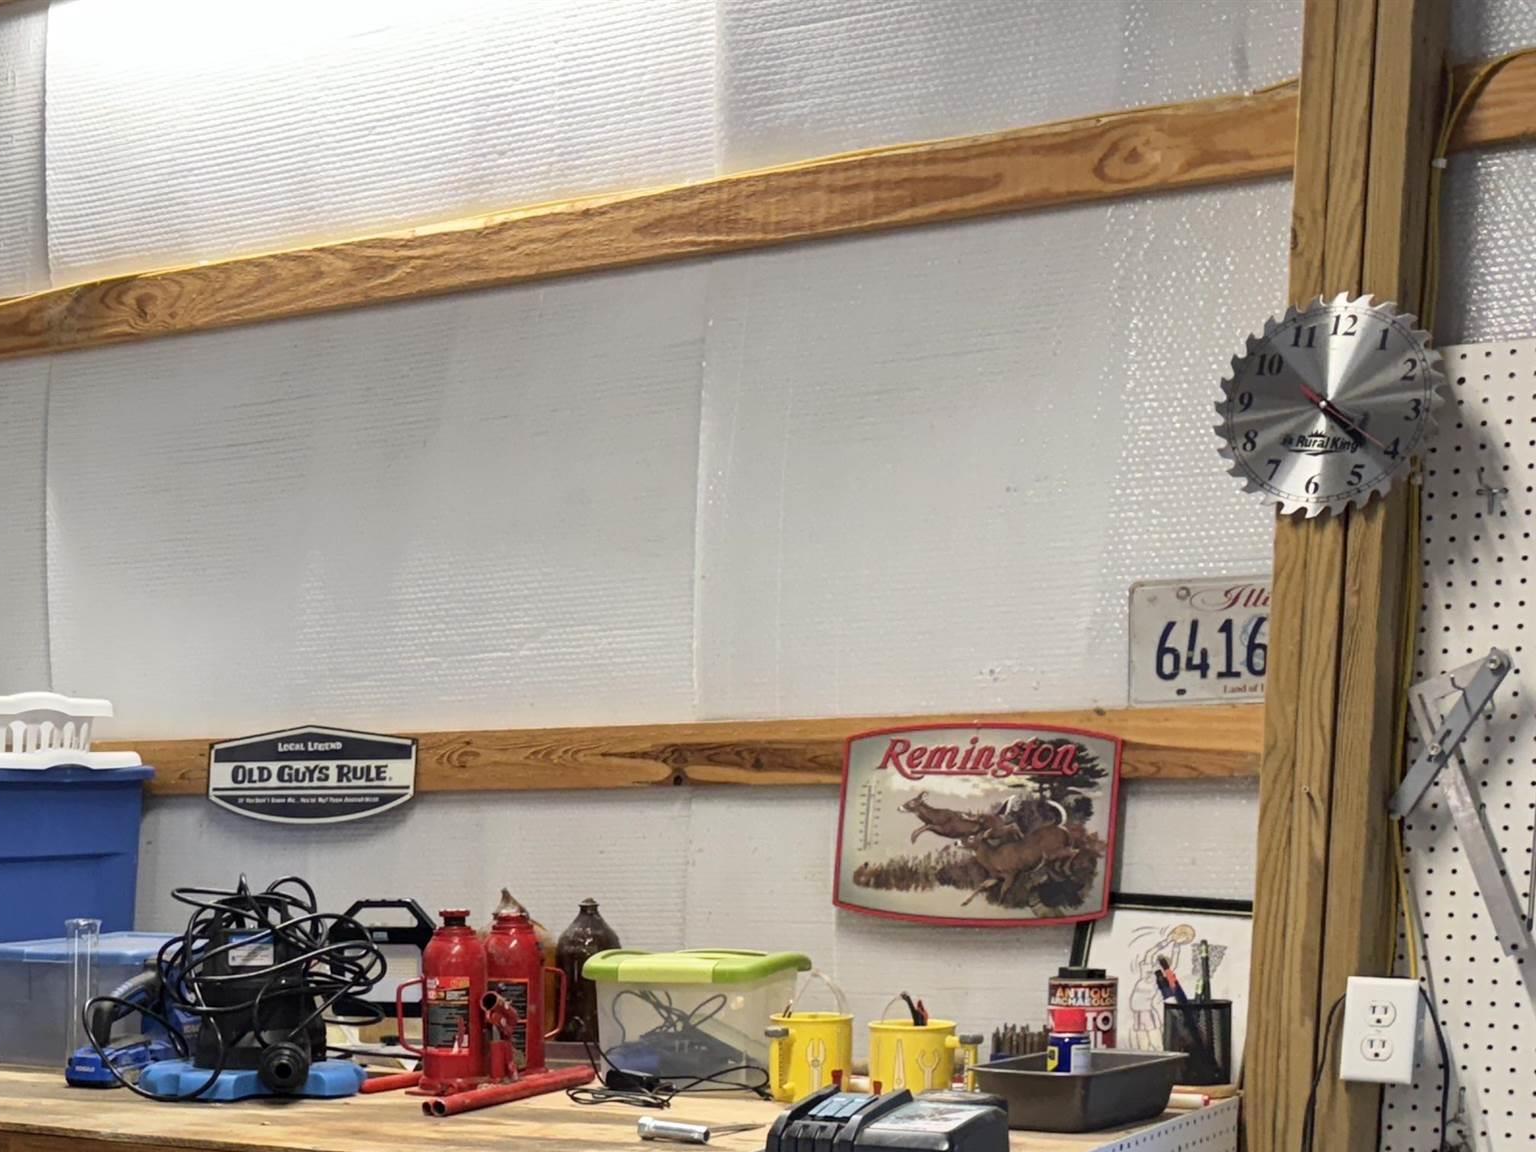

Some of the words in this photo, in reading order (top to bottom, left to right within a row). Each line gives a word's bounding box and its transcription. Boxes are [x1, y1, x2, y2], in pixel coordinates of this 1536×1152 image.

[1330, 314, 1358, 336] 12
[1291, 325, 1317, 348] 11
[1376, 328, 1389, 350] 1
[1256, 353, 1284, 377] 10
[1401, 358, 1417, 381] 2
[1239, 391, 1254, 413] 9
[1404, 398, 1421, 421] 3
[1242, 429, 1258, 451] 8
[1296, 435, 1330, 449] Rural
[1330, 436, 1359, 454] King
[1383, 437, 1400, 460] 4
[1265, 458, 1281, 481] 7
[1347, 464, 1365, 486] 5
[1305, 473, 1319, 495] 6
[278, 741, 306, 752] LOCAL
[307, 740, 343, 752] LEGEND
[878, 736, 1080, 780] Remington
[231, 765, 272, 784] OLD
[277, 764, 330, 783] GUYS
[1056, 986, 1113, 998] ANTIQU
